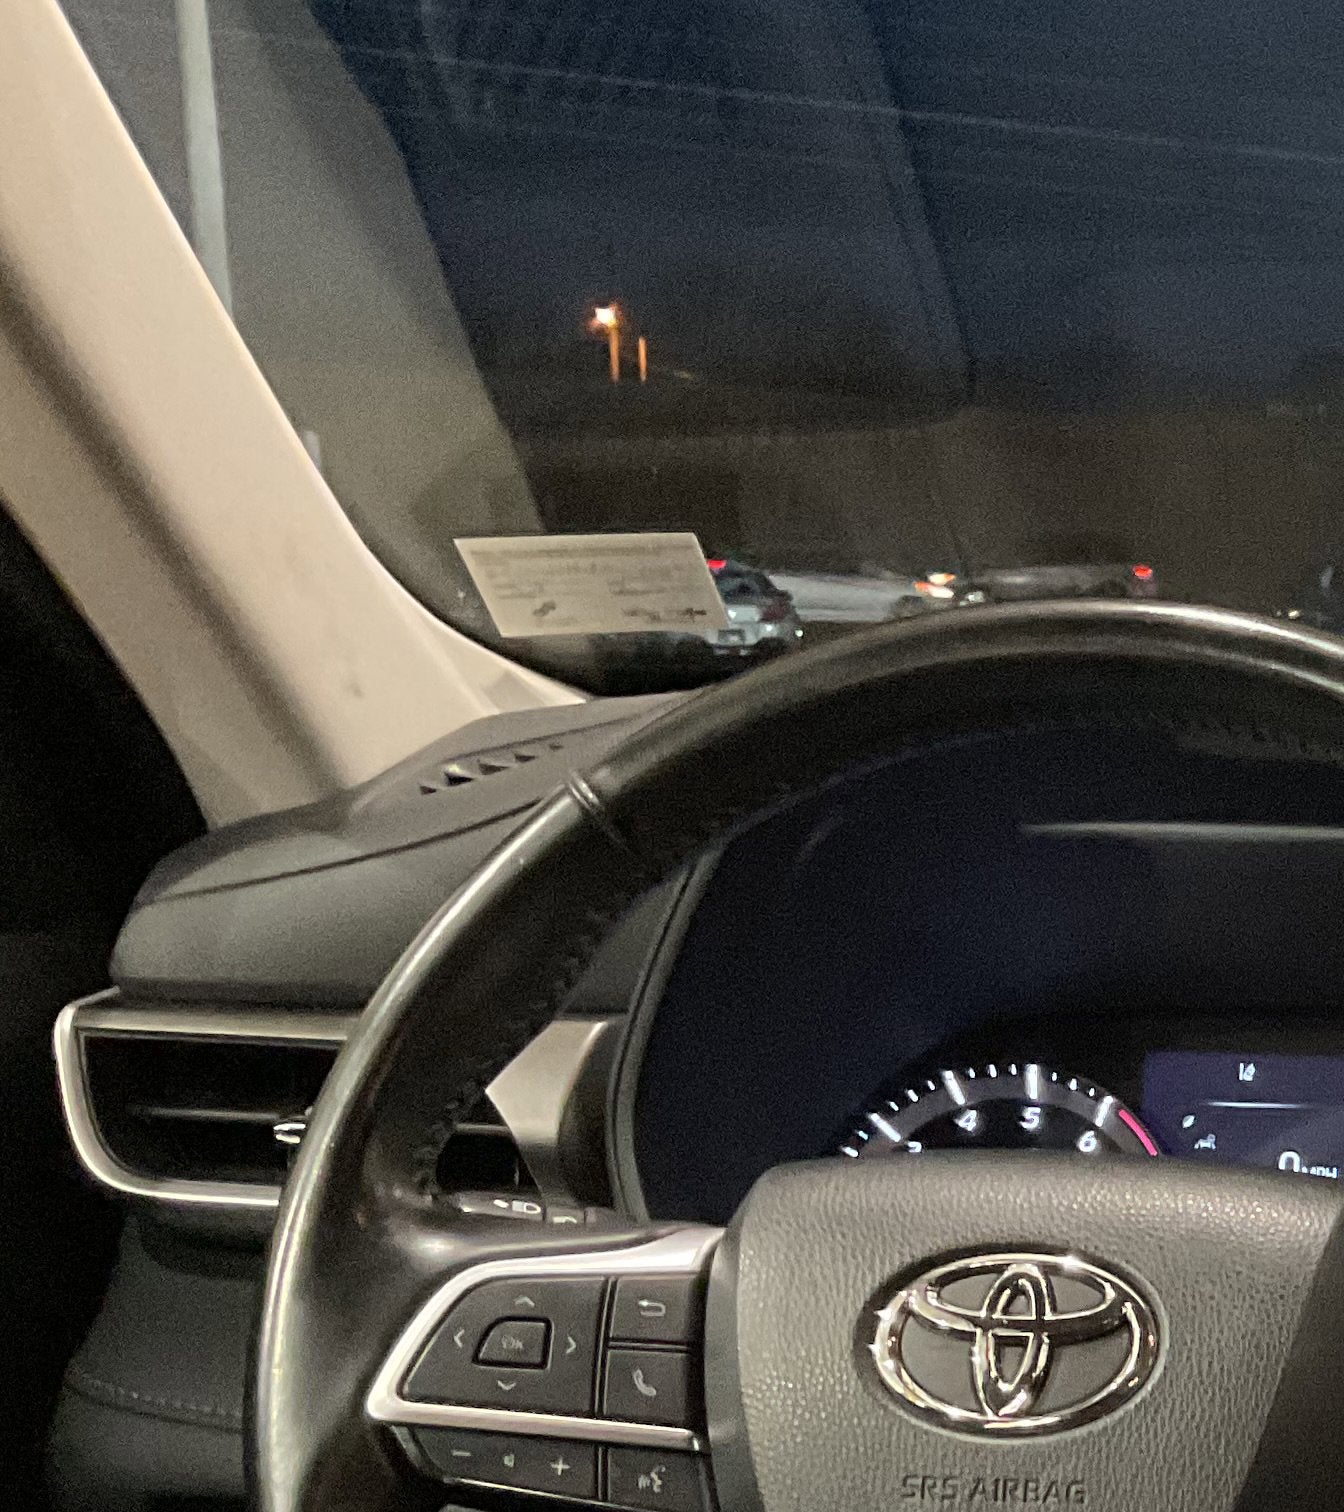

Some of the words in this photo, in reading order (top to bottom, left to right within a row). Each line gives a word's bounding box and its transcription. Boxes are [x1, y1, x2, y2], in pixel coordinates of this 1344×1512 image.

[953, 1109, 977, 1132] 4
[1019, 1106, 1041, 1129] 5
[1080, 1130, 1098, 1152] 6
[902, 1474, 958, 1500] SRS
[968, 1478, 1086, 1504] AIRBAG
